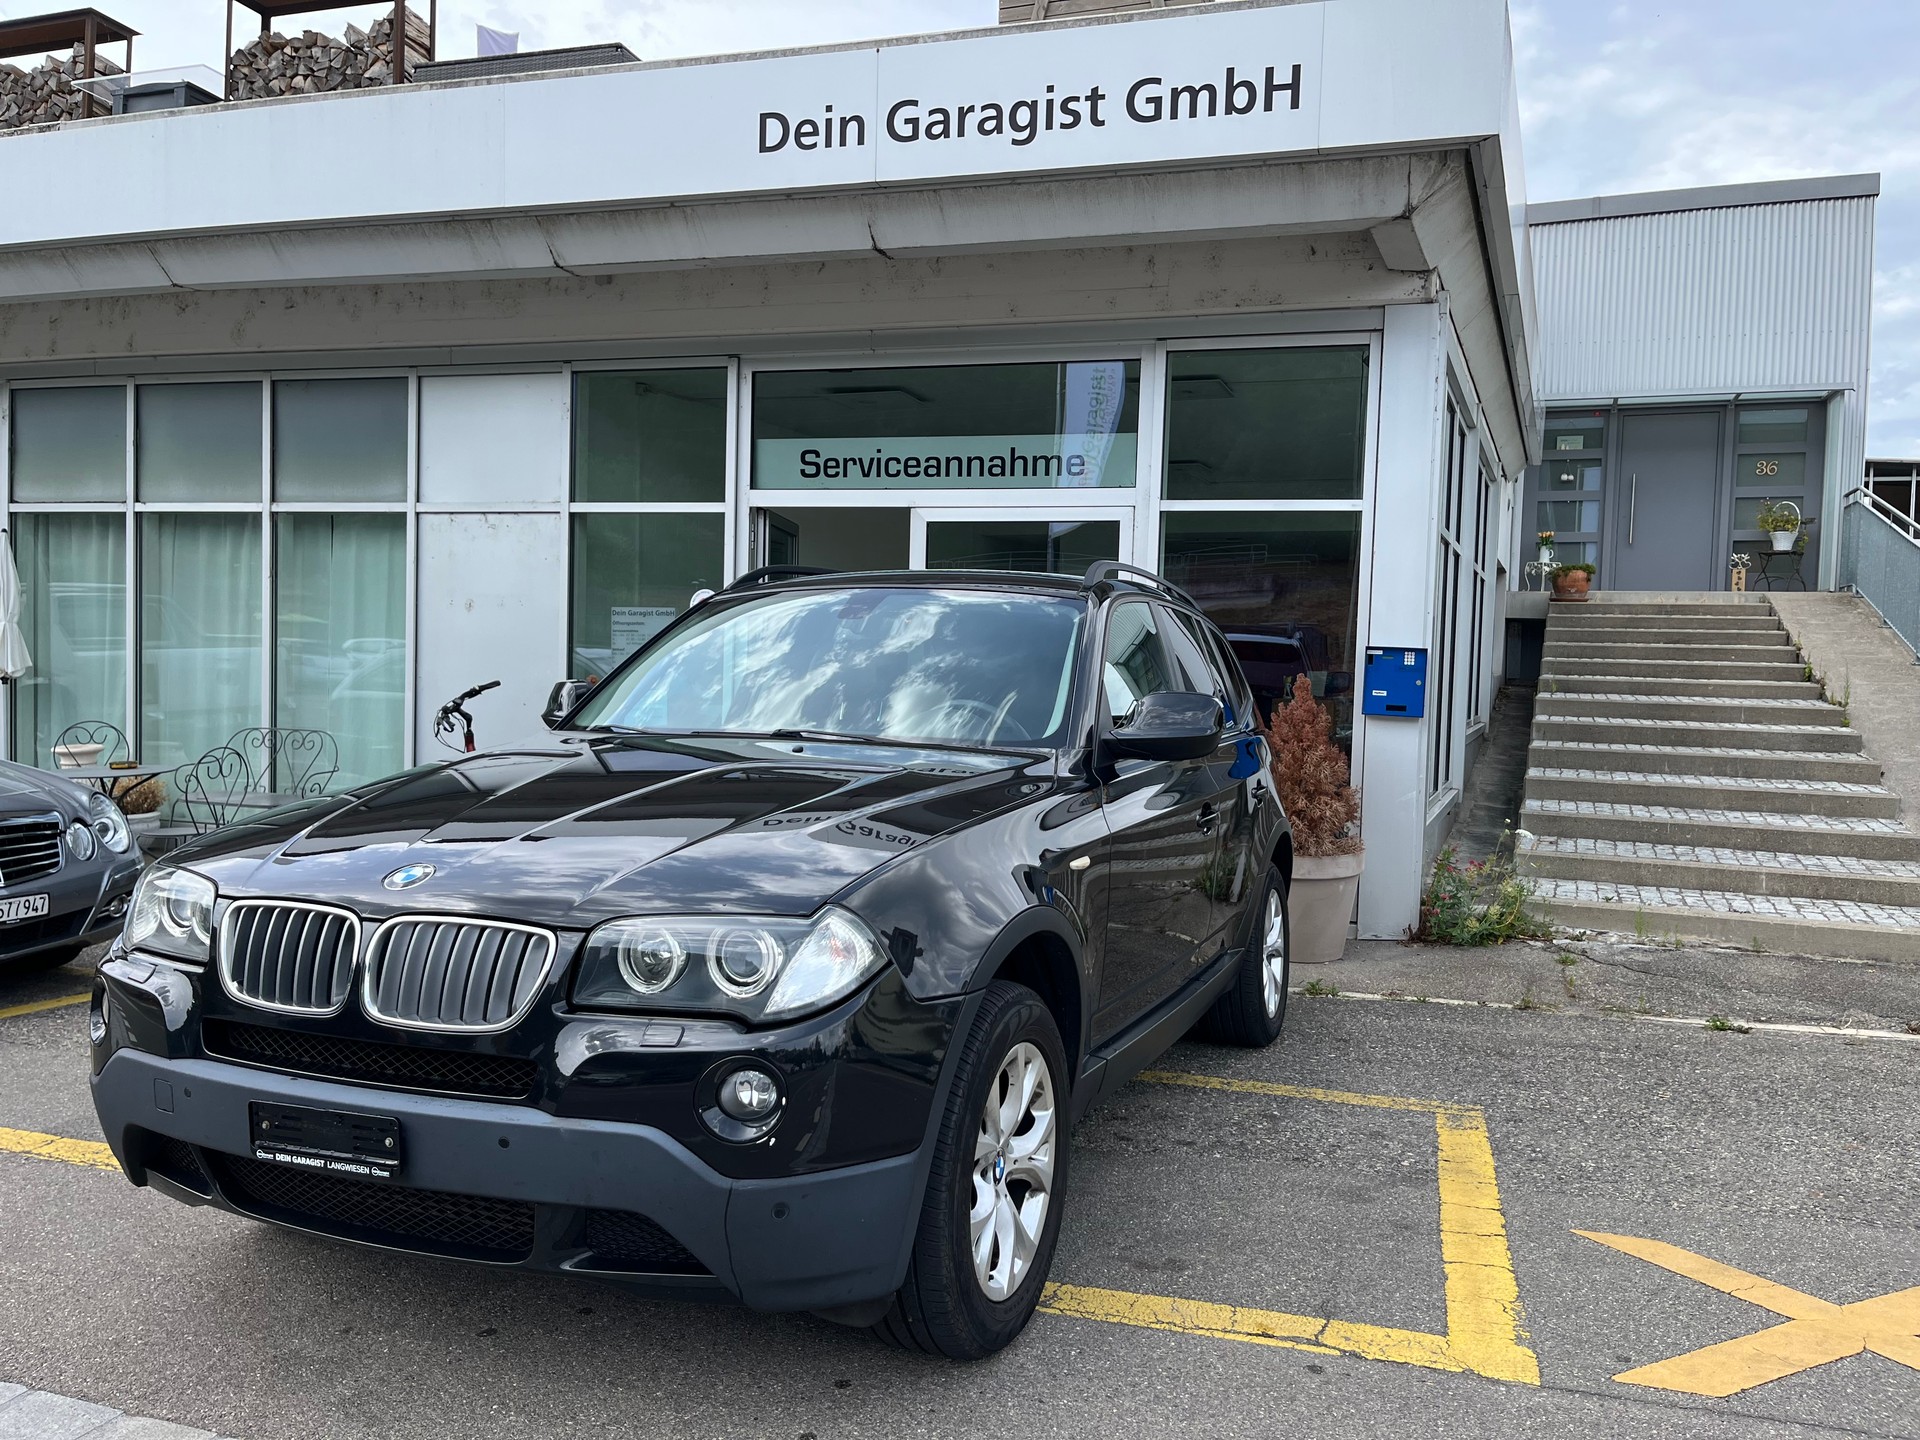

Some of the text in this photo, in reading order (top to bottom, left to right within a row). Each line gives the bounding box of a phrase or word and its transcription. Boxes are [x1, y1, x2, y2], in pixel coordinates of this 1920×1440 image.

[758, 64, 1302, 153] Dein Garagist GmbH
[799, 447, 1086, 478] Serviceannahme
[1756, 460, 1778, 475] 36
[628, 609, 654, 617] Garagist
[275, 1153, 291, 1162] DEIN
[292, 1156, 325, 1167] GARAGIST
[327, 1160, 370, 1174] LANGWIESEN
